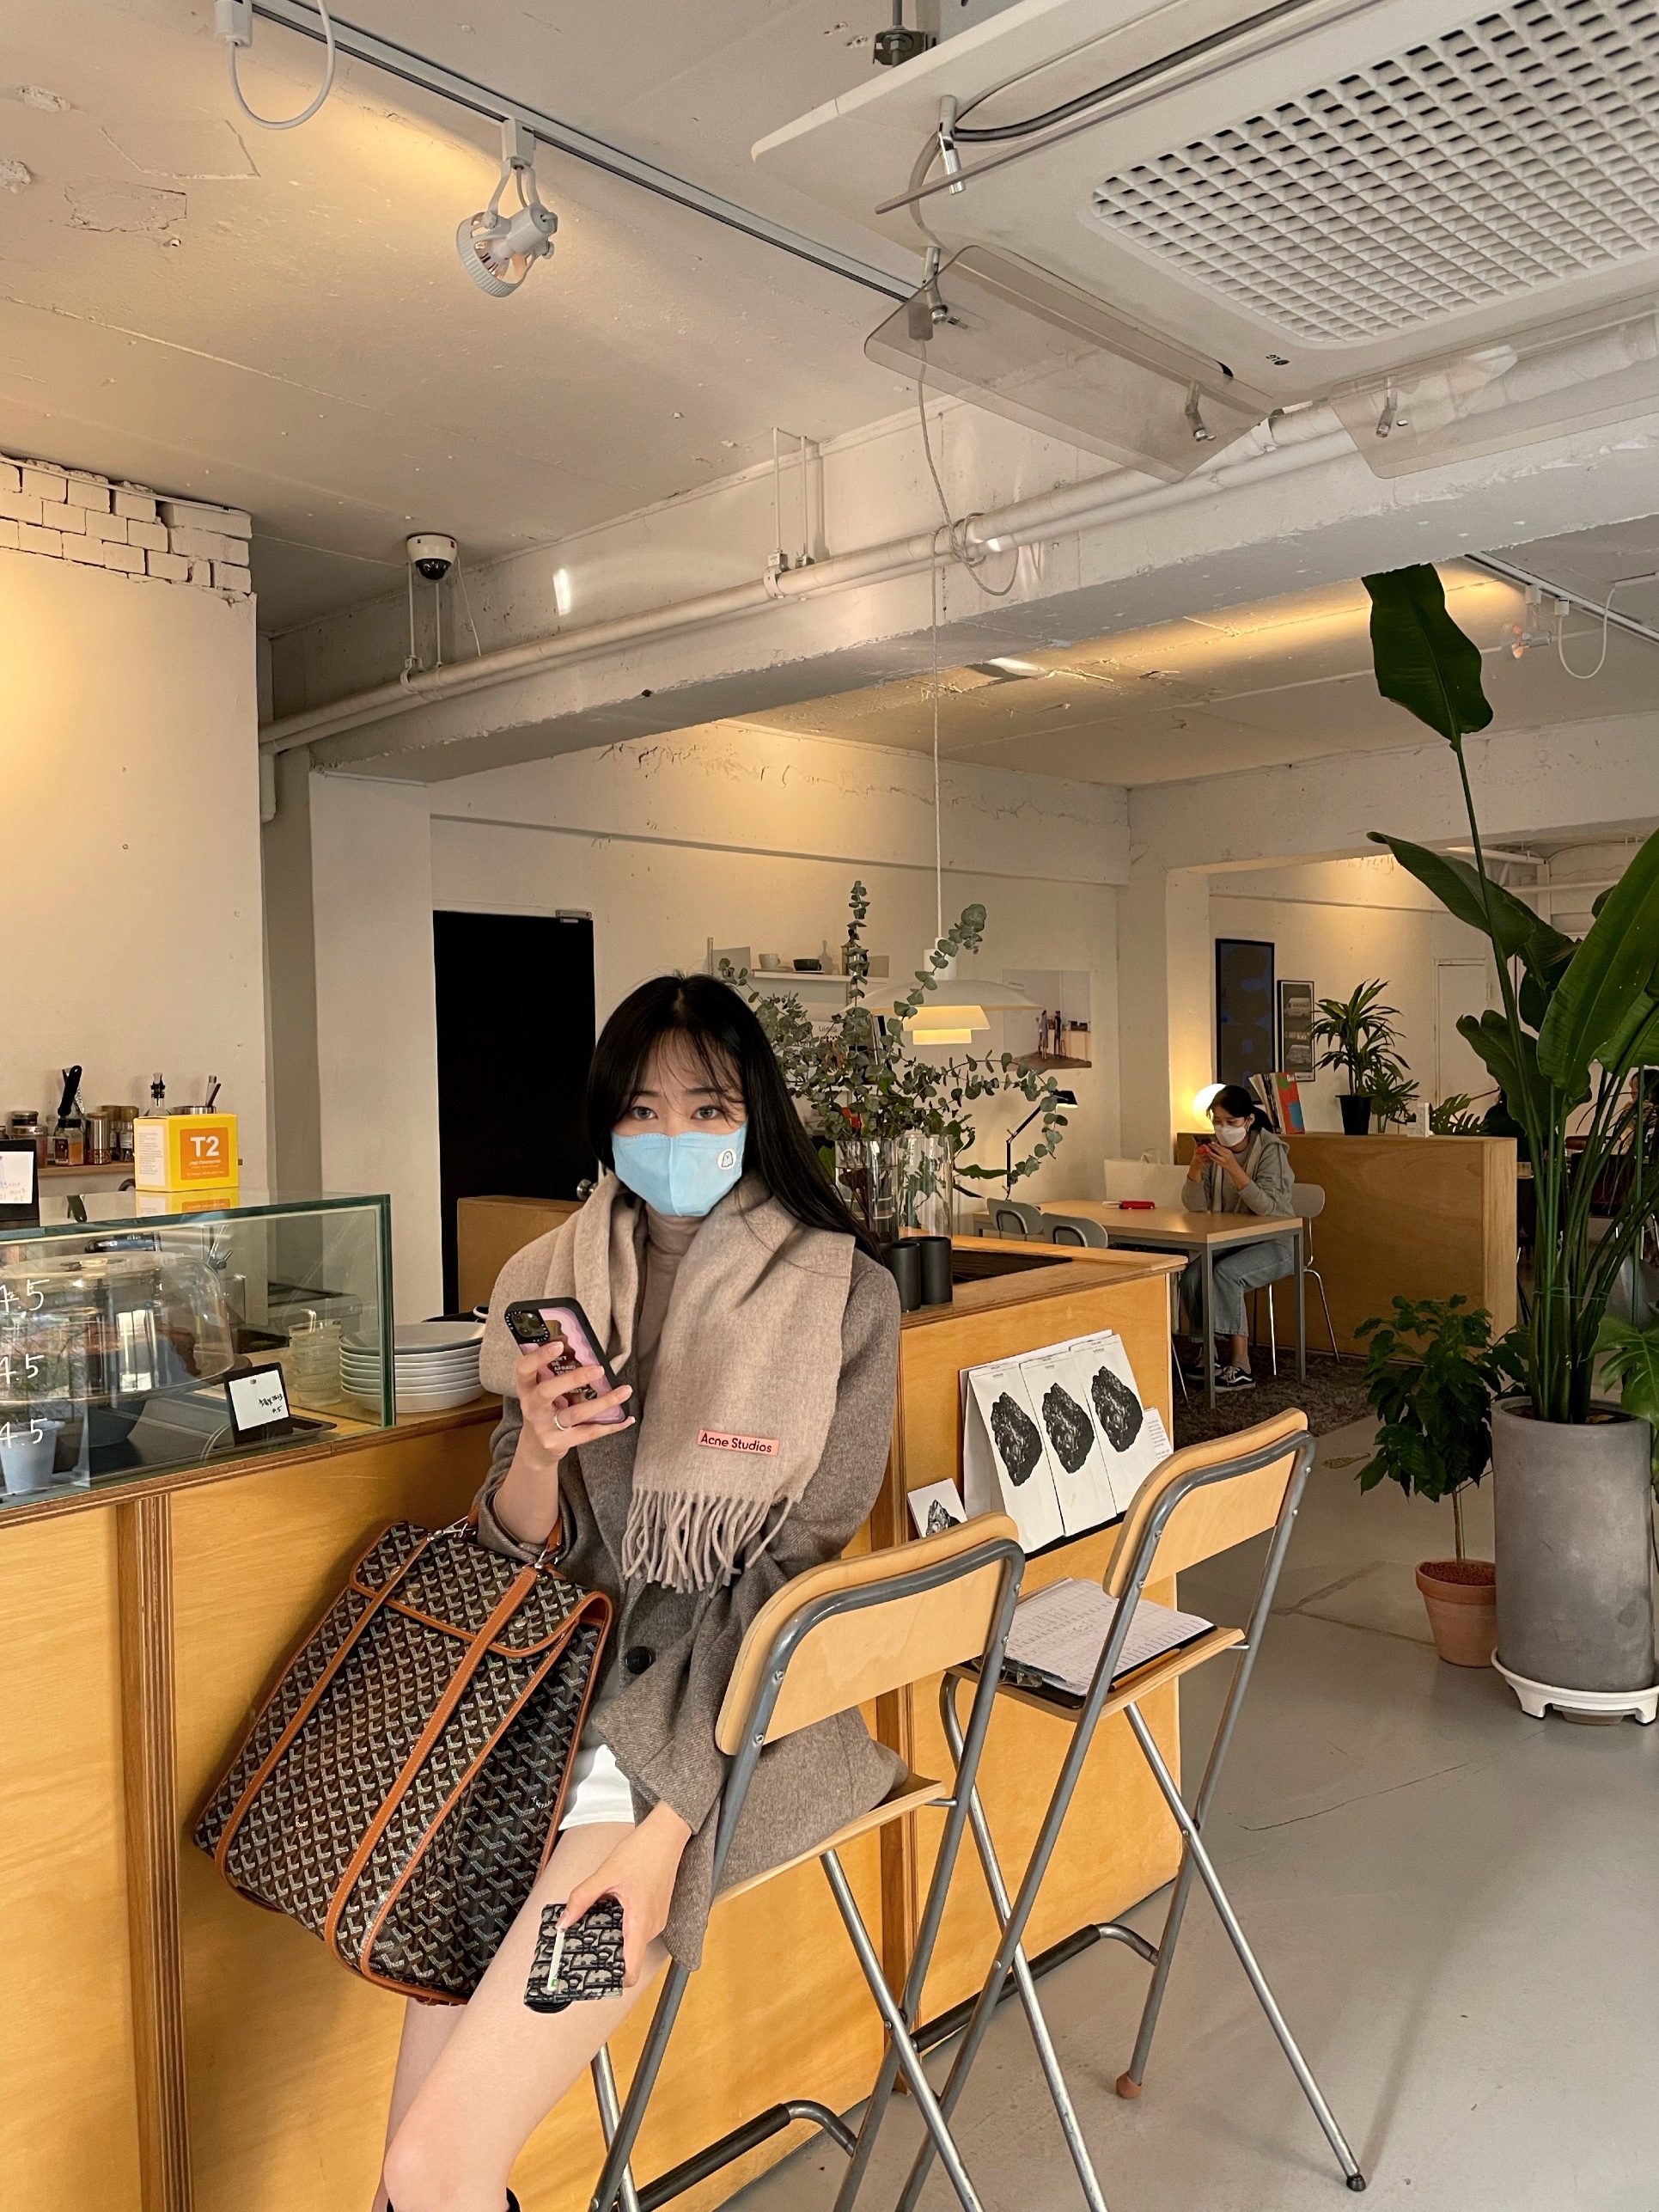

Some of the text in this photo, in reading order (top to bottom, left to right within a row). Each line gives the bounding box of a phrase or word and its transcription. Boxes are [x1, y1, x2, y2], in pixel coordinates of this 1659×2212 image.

[190, 1135, 220, 1158] T2
[700, 1433, 772, 1453] Acne Studios
